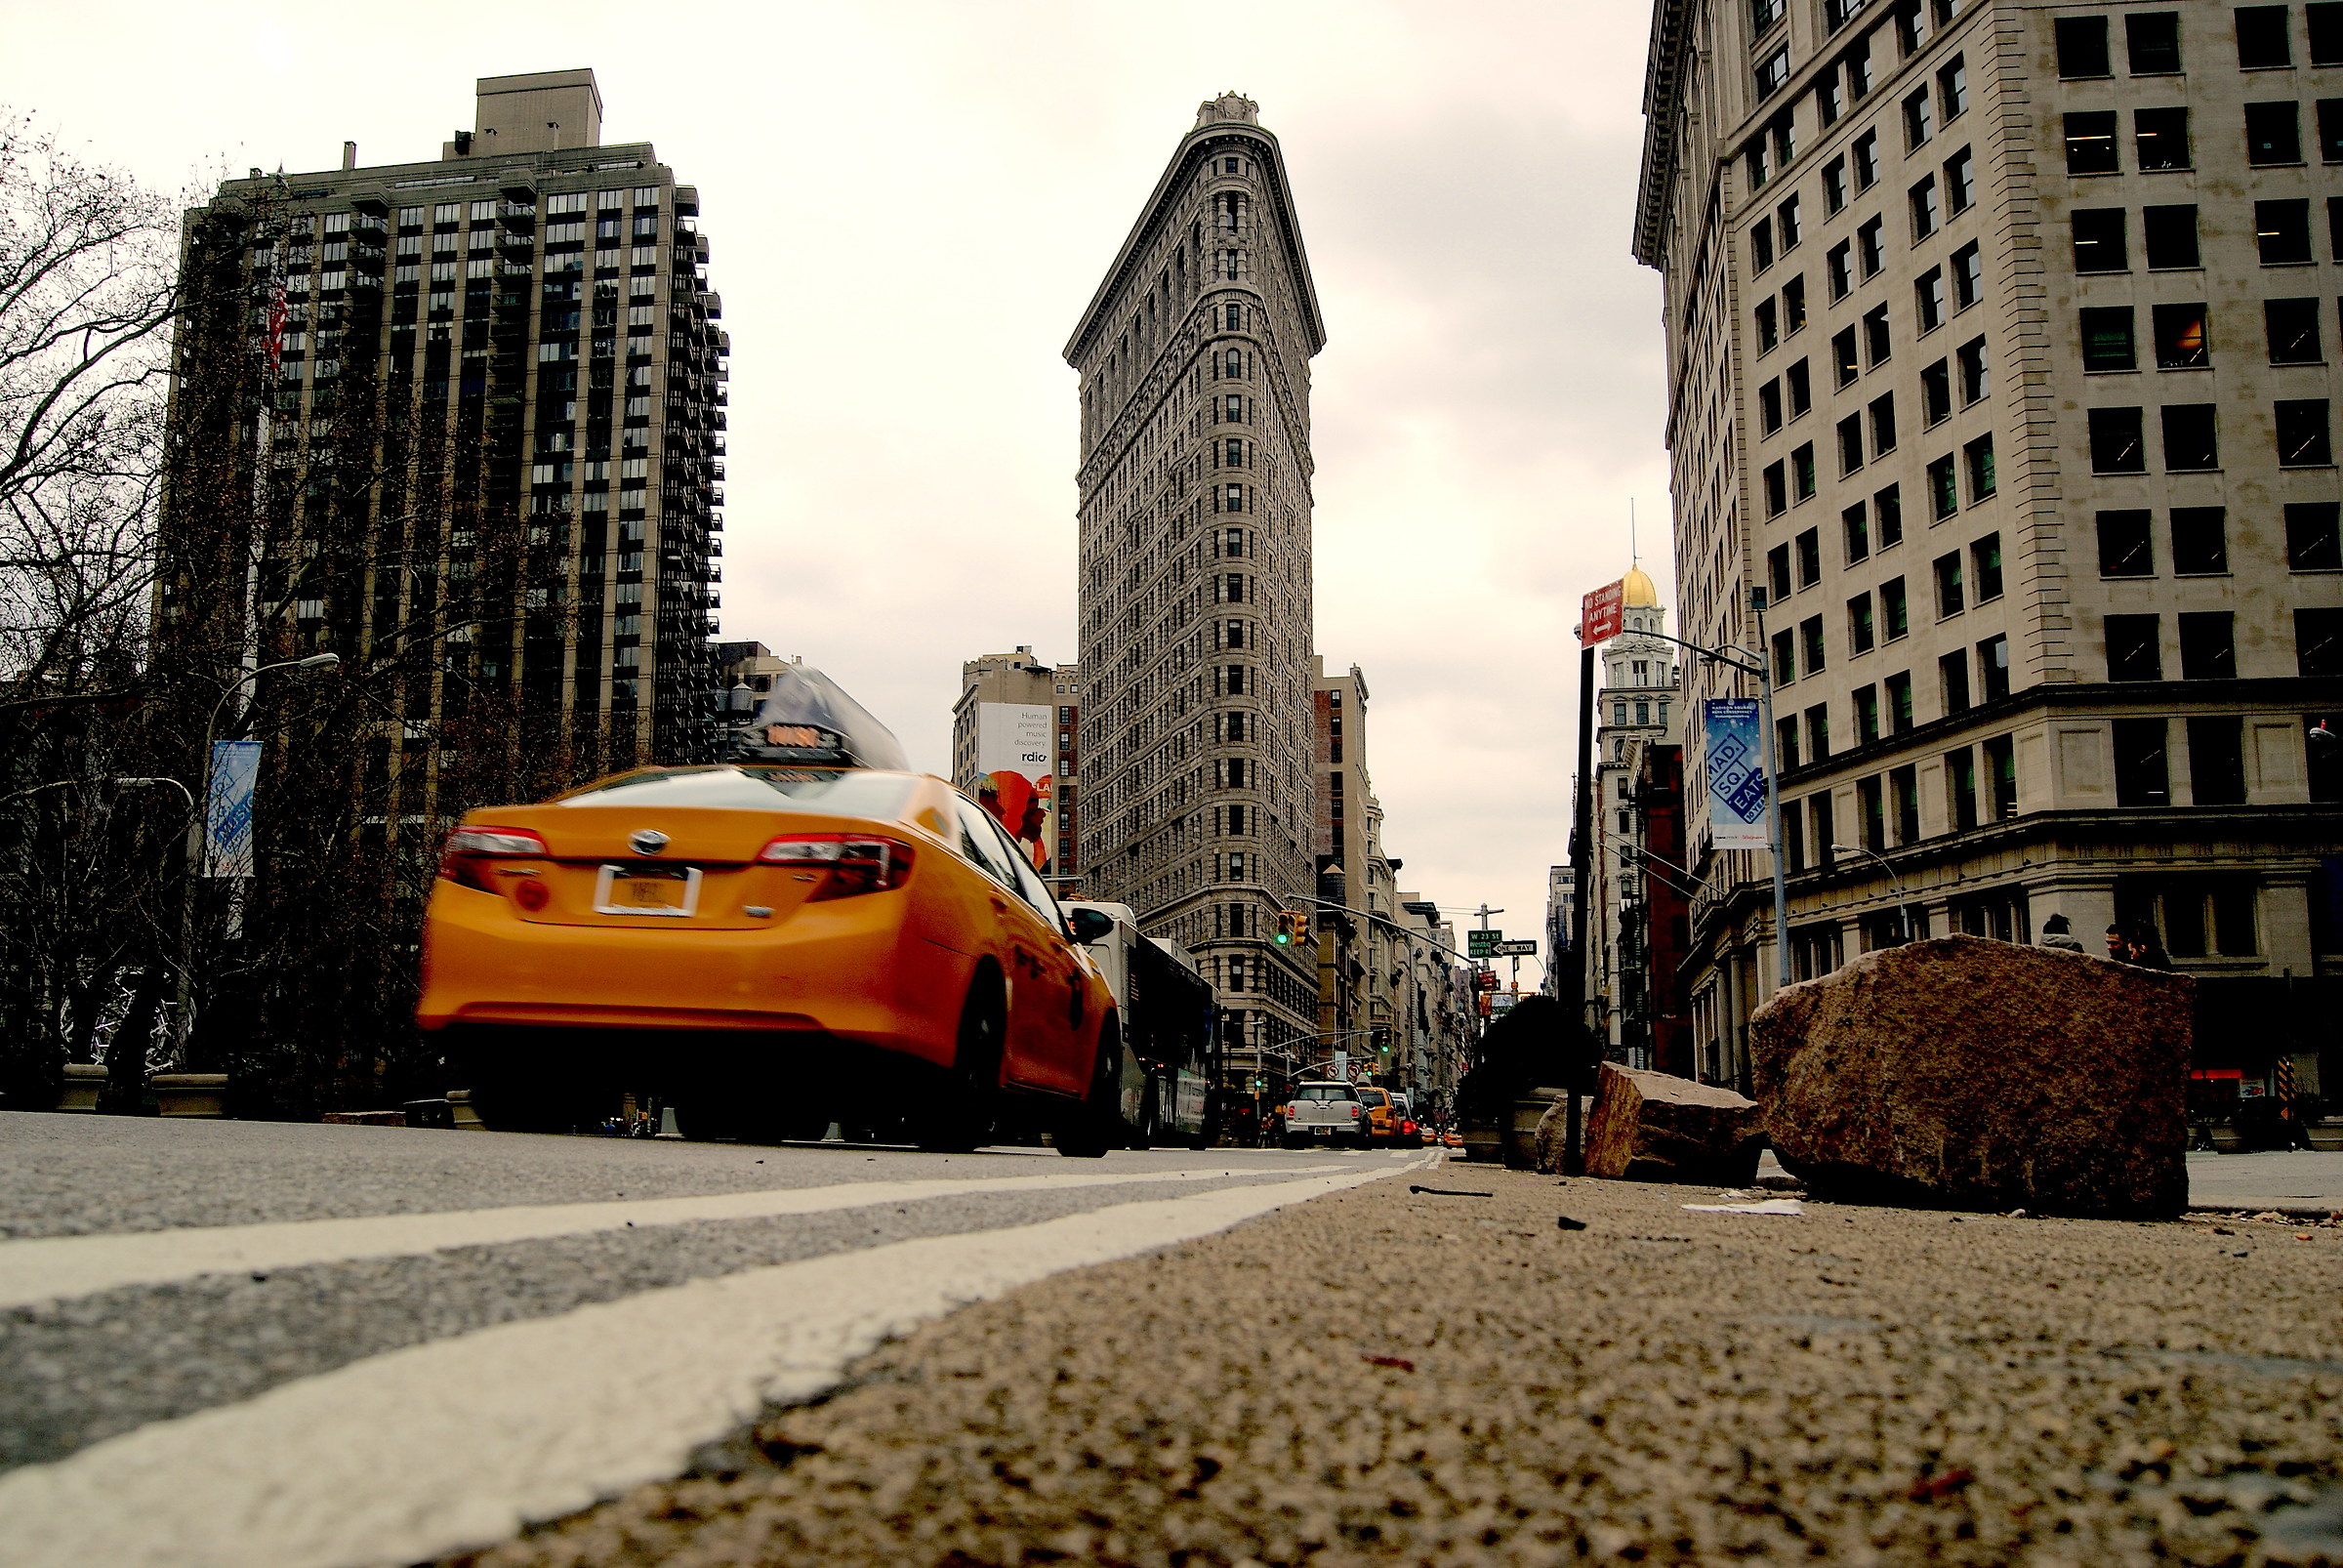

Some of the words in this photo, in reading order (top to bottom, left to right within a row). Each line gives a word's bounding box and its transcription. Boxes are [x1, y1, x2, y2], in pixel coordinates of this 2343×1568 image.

[1584, 598, 1593, 609] NO
[1594, 586, 1622, 606] STANDING
[1588, 602, 1618, 623] ANYTIME
[1014, 739, 1046, 748] discovery
[1021, 751, 1048, 762] rdio
[1718, 772, 1746, 795] SQ.
[1746, 811, 1754, 820] 10
